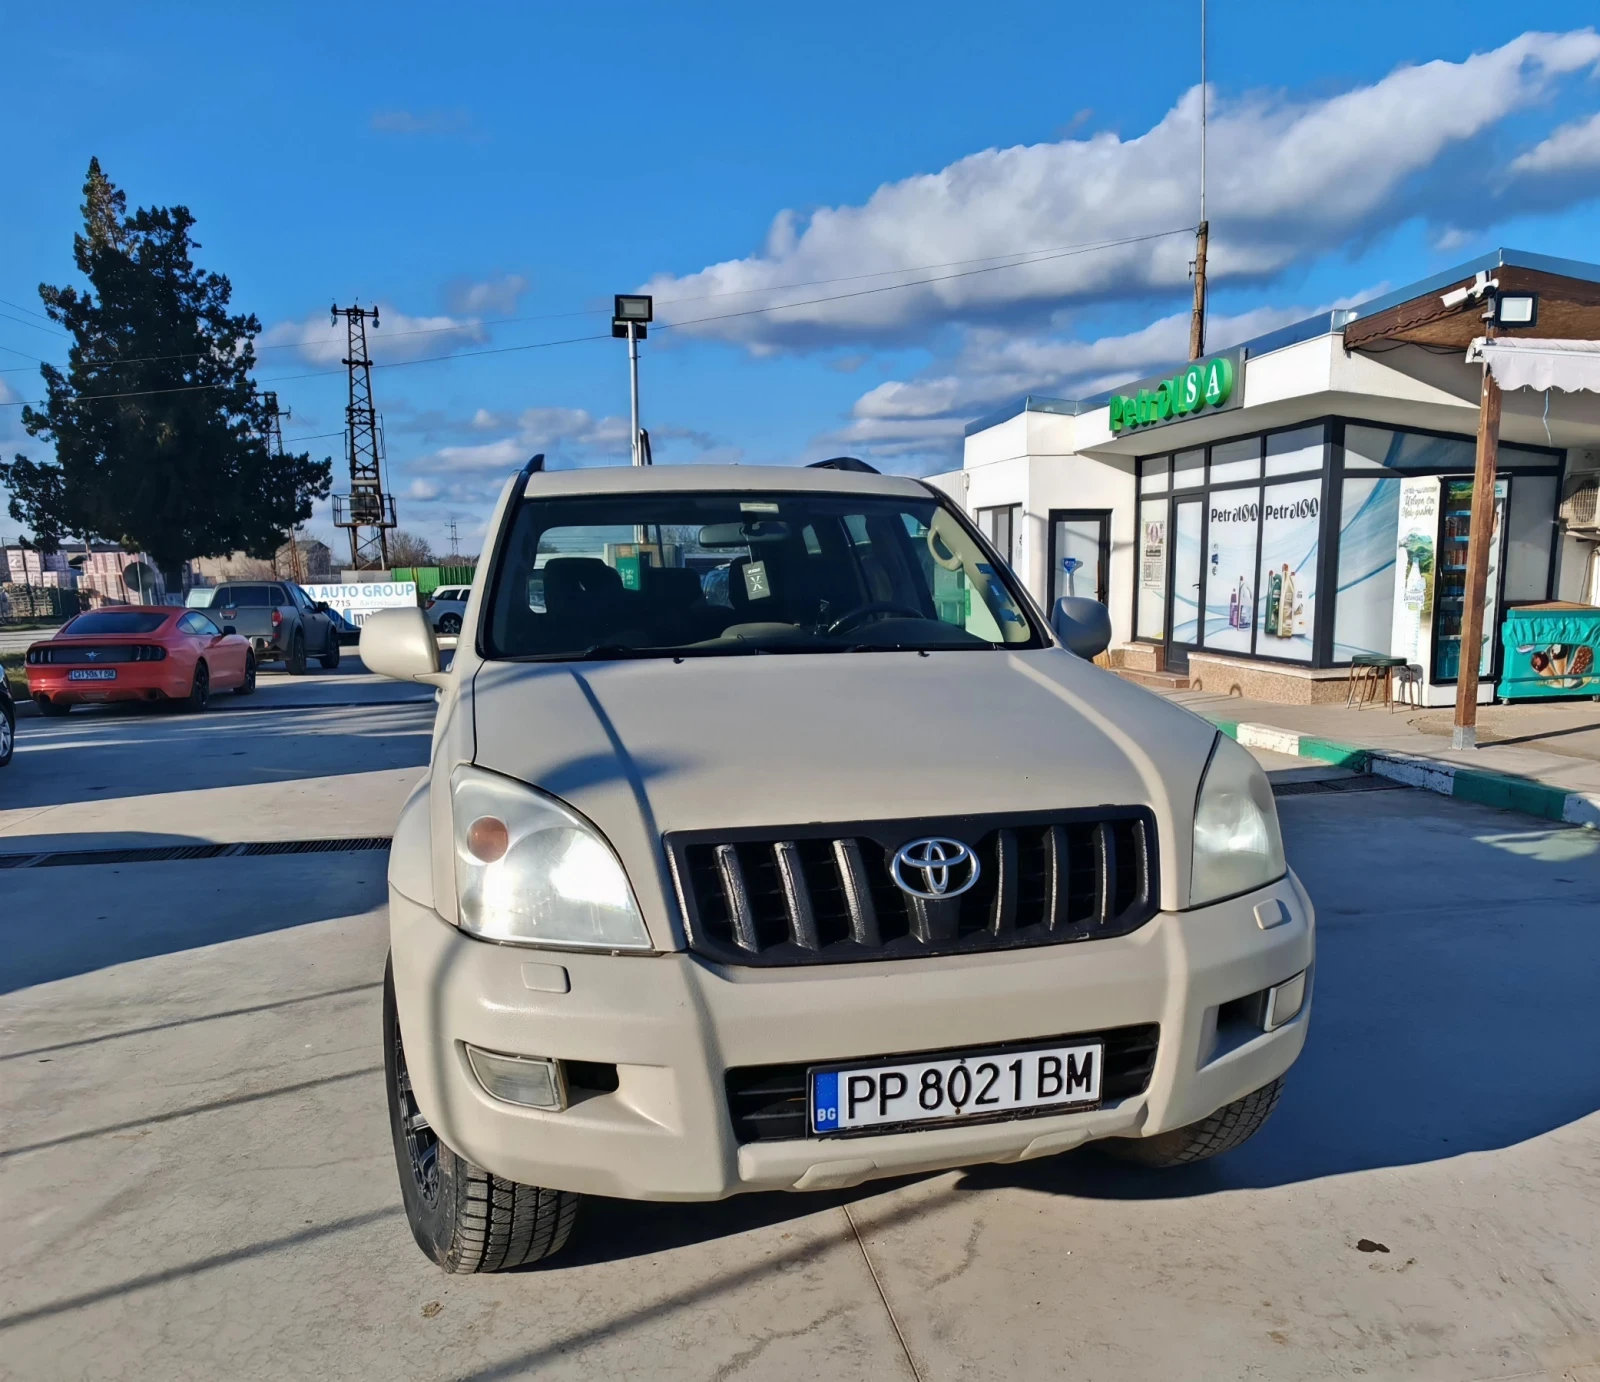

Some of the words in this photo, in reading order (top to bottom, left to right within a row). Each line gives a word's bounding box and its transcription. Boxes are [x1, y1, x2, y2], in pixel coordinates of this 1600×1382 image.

[320, 585, 359, 598] AUTO
[362, 583, 415, 597] GROUP
[847, 1072, 908, 1120] PP
[918, 1059, 1023, 1110] 8021
[1037, 1051, 1093, 1098] BM
[817, 1107, 836, 1122] BG
